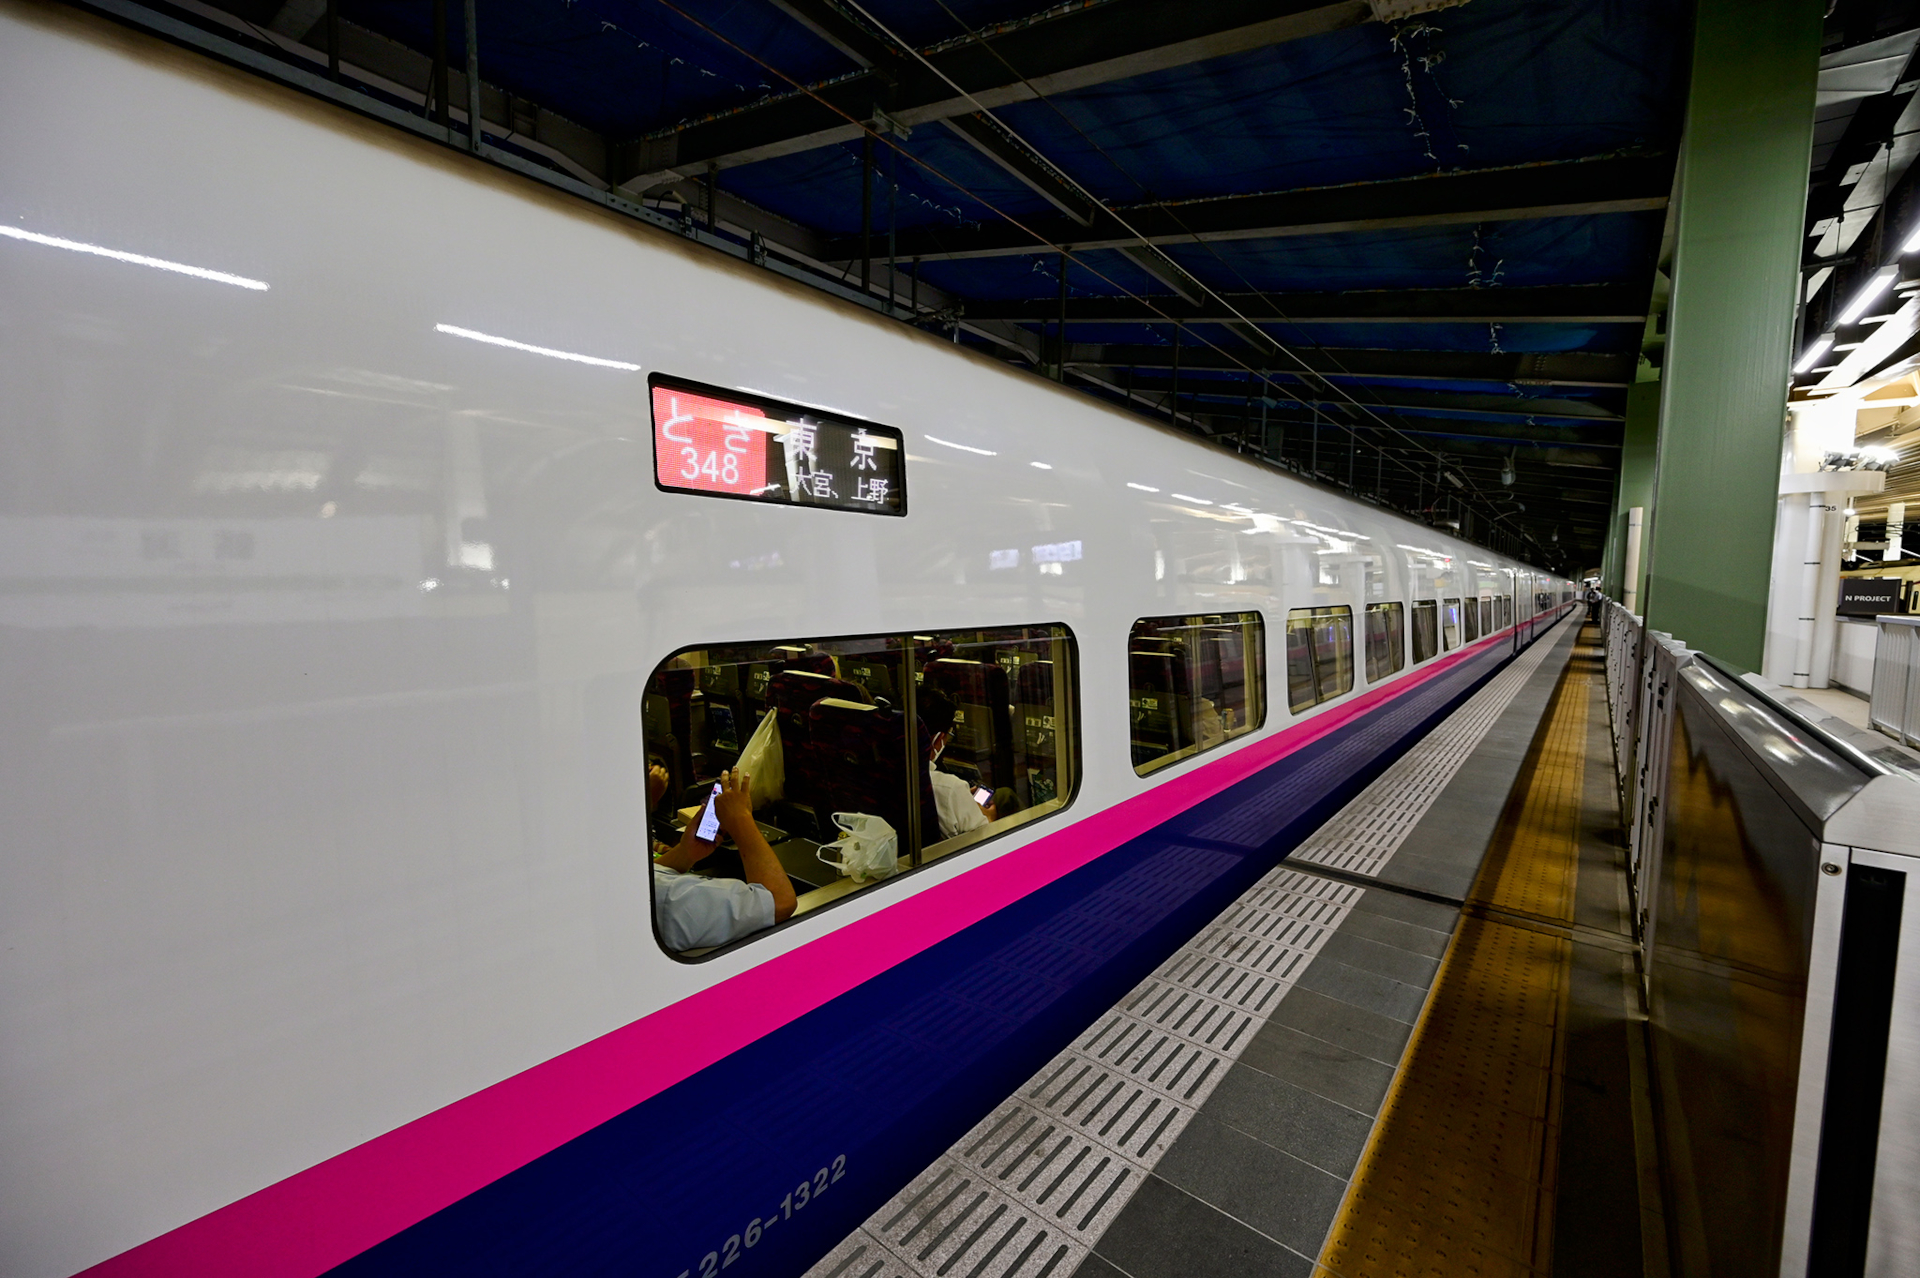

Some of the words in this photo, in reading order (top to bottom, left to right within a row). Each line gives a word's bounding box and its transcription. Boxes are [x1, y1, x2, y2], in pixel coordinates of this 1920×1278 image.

[662, 397, 752, 454] とき
[786, 418, 877, 471] 東京
[680, 446, 740, 485] 348
[676, 1154, 846, 1278] 226-1322
